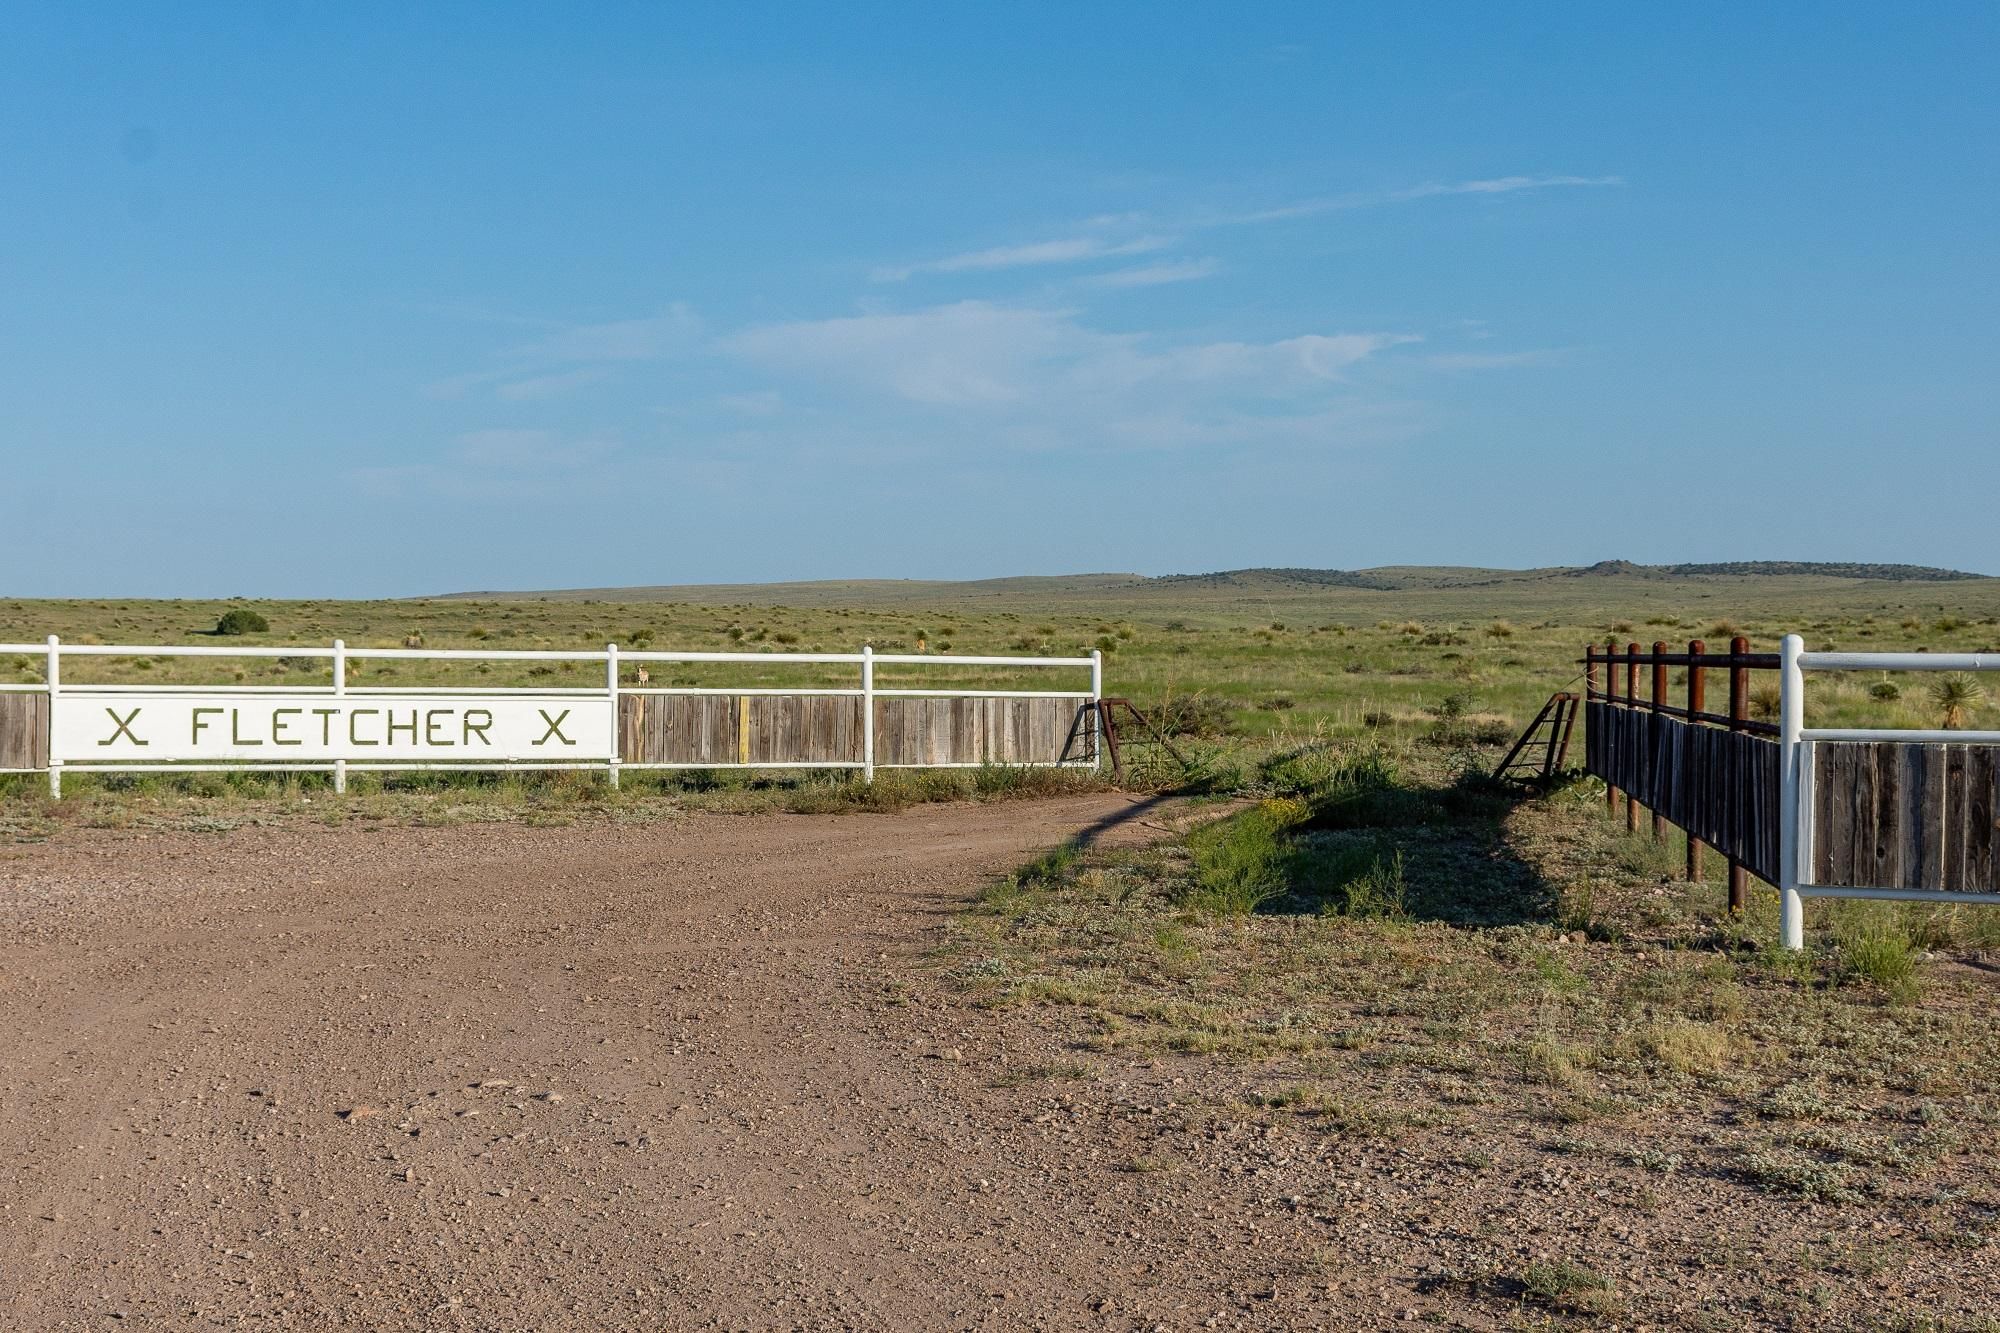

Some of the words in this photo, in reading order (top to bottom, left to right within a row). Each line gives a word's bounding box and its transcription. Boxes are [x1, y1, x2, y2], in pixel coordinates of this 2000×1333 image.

[98, 707, 149, 746] X
[192, 708, 493, 746] FLETCHER
[531, 709, 577, 746] X
